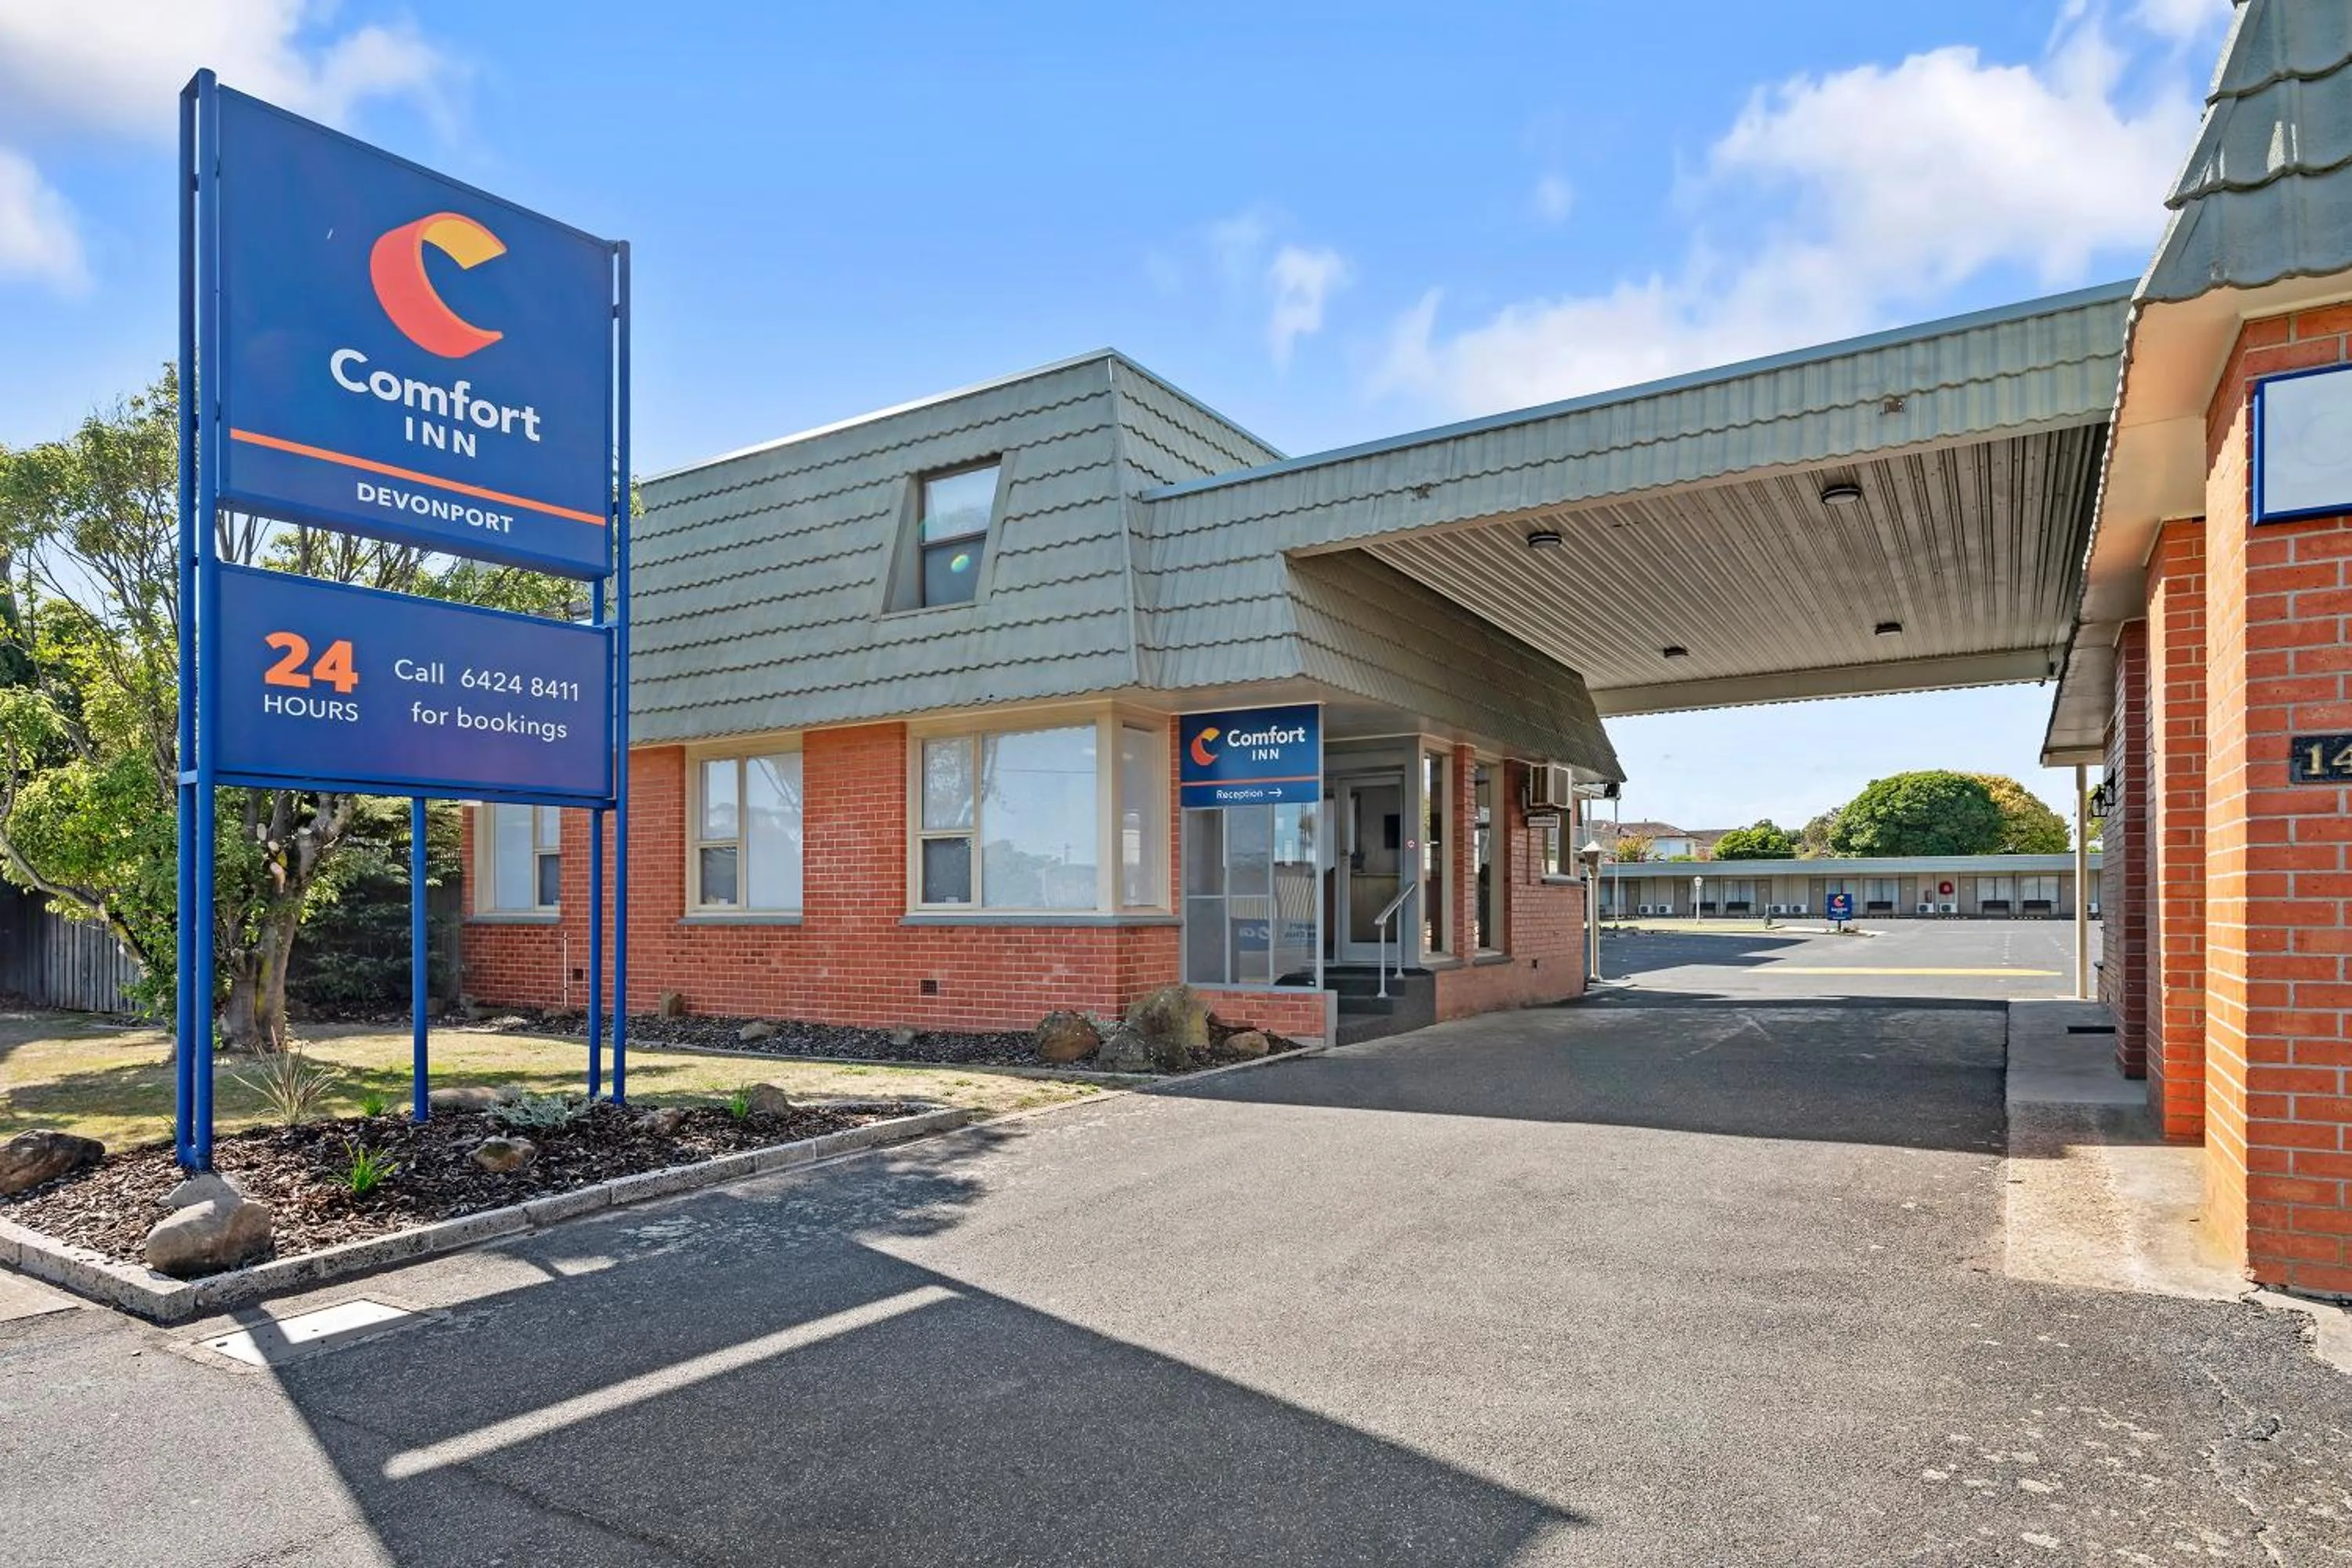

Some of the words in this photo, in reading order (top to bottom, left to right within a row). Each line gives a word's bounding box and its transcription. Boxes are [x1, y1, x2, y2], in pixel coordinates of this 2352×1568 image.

[329, 347, 541, 441] Comfort
[405, 416, 477, 458] INN
[356, 481, 514, 534] DEVONPORT
[263, 631, 359, 694] 24
[394, 659, 445, 685] Call
[460, 668, 523, 695] 6424
[530, 677, 579, 702] 8411
[263, 693, 359, 723] HOURS
[411, 701, 448, 725] for
[456, 706, 568, 743] bookings
[1227, 725, 1305, 747] Comfort
[1252, 748, 1279, 760] INN
[1216, 788, 1264, 800] Reception
